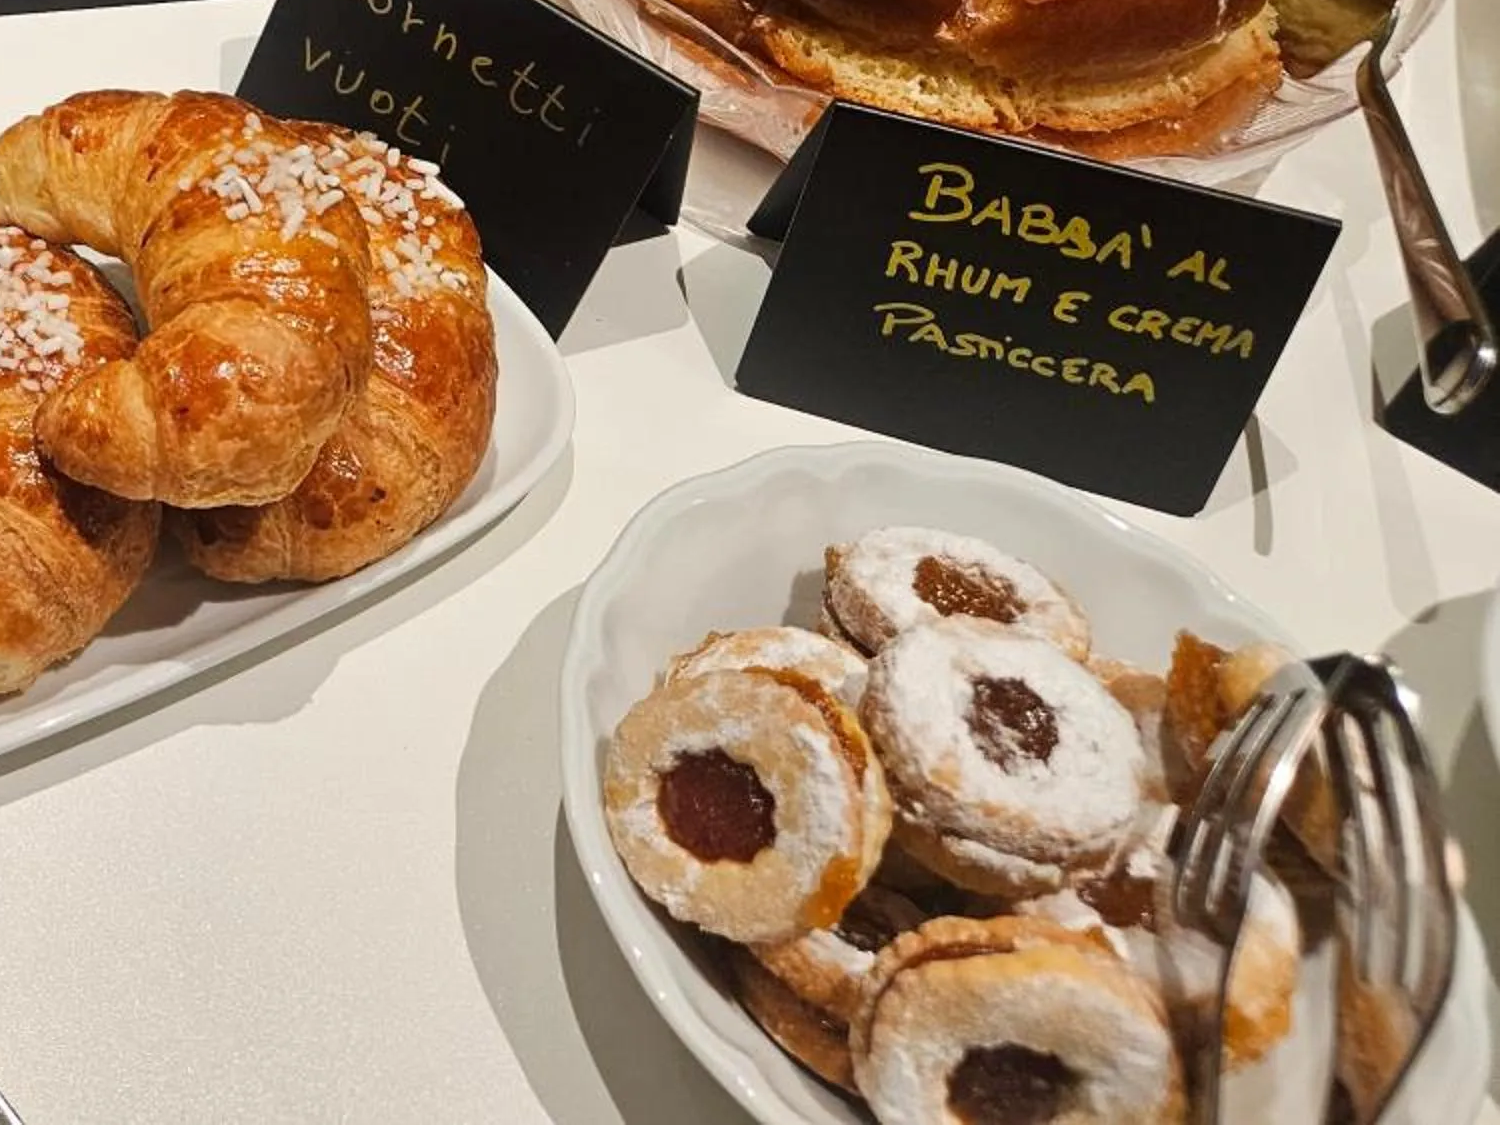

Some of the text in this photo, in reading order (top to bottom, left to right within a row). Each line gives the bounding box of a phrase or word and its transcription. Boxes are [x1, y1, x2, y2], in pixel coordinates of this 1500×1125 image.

[304, 36, 456, 167] vuoti
[885, 239, 1257, 360] RHUM E CREMA
[1165, 249, 1233, 291] AL
